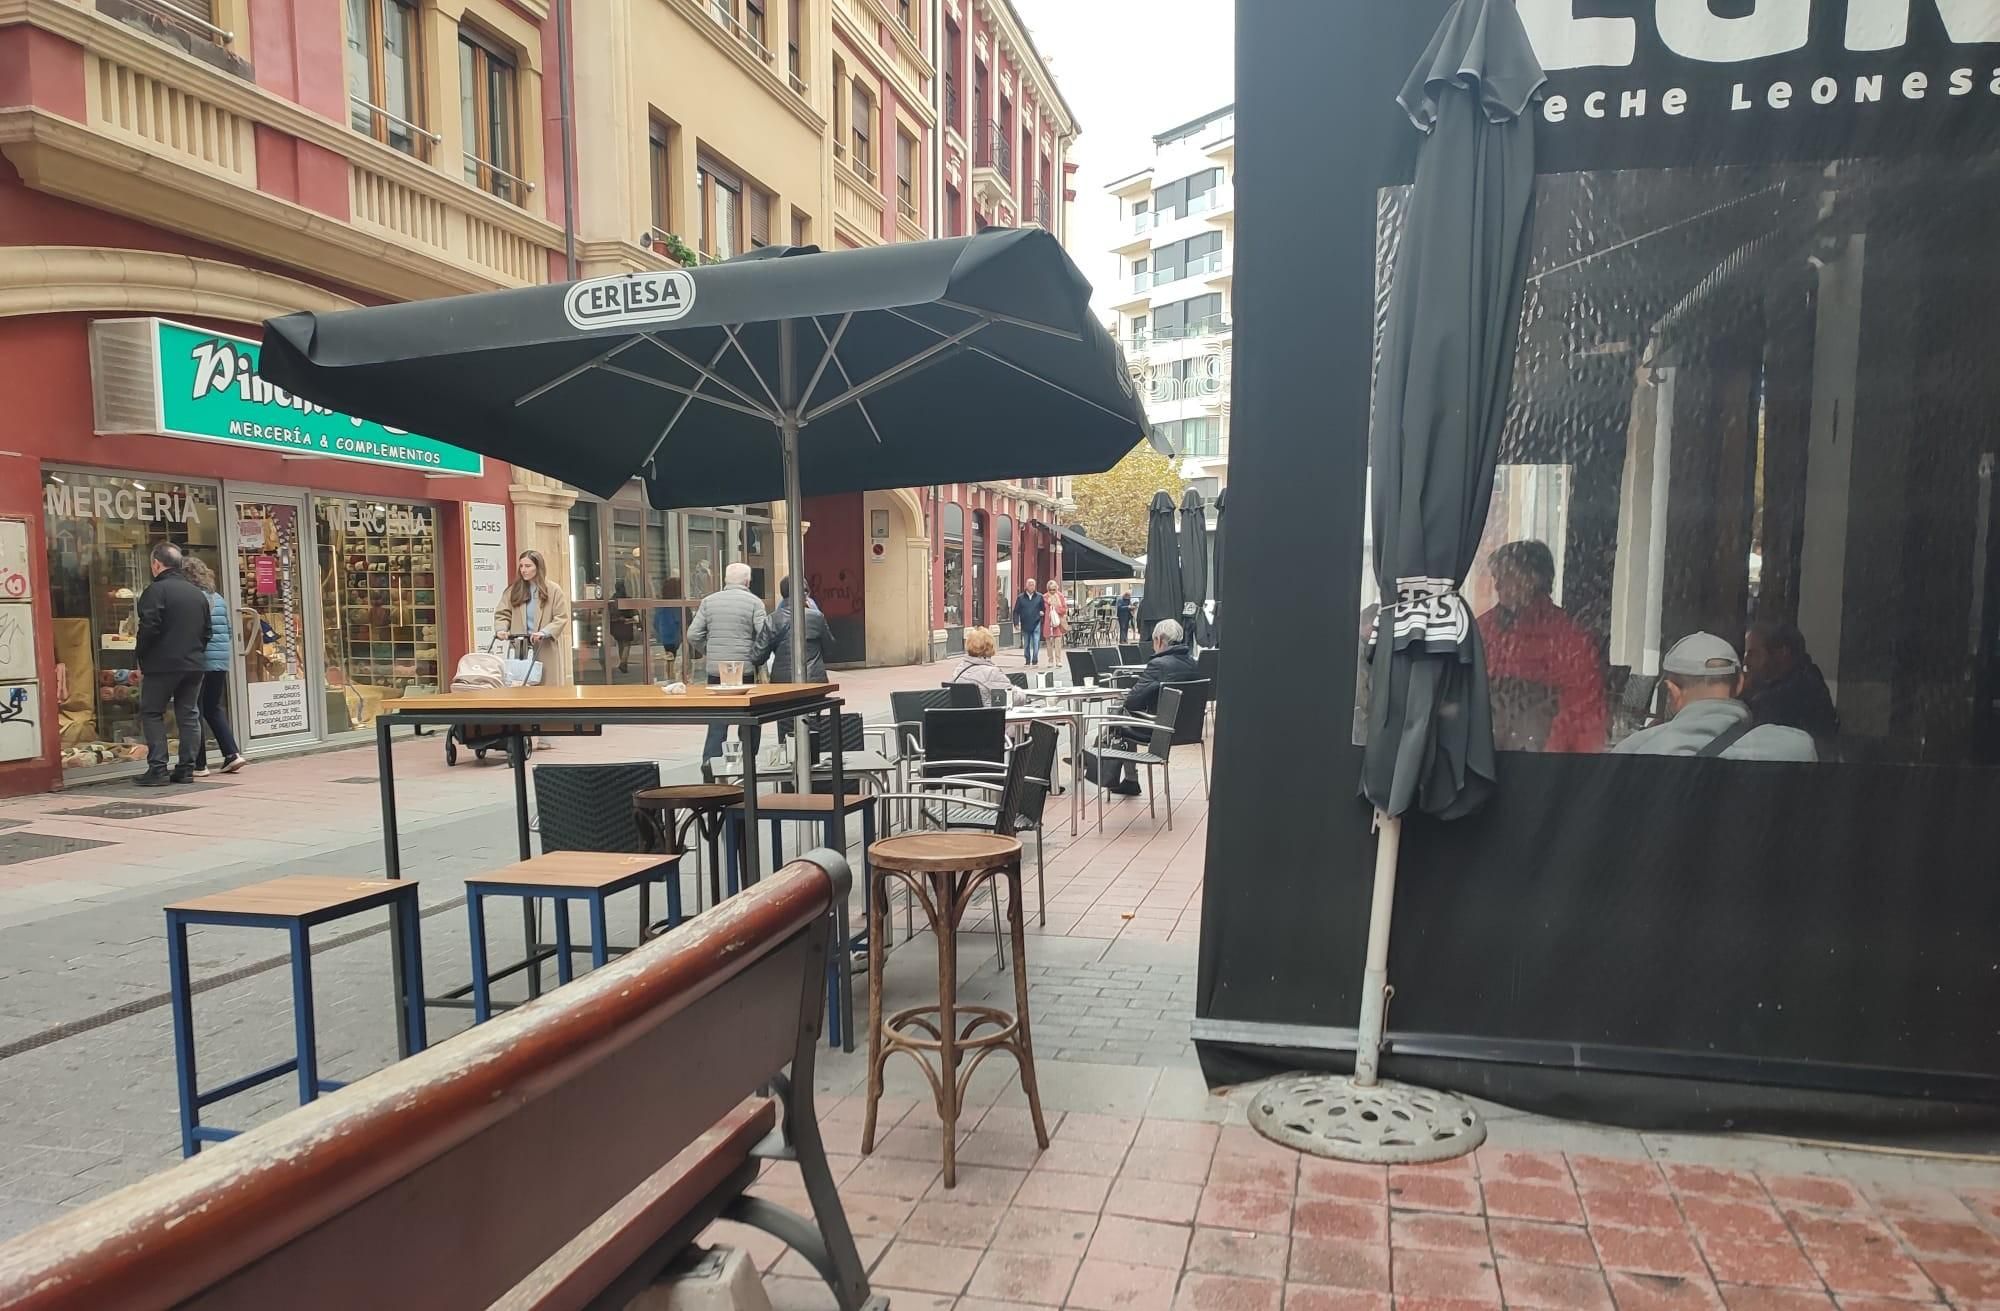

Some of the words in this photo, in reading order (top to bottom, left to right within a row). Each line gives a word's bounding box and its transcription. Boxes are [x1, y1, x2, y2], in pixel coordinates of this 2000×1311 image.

[574, 278, 681, 318] CERLESA
[229, 419, 312, 446] MERCERÍA
[320, 434, 329, 448] &
[336, 437, 441, 465] COMPLEMENTOS
[472, 519, 501, 532] CLASES
